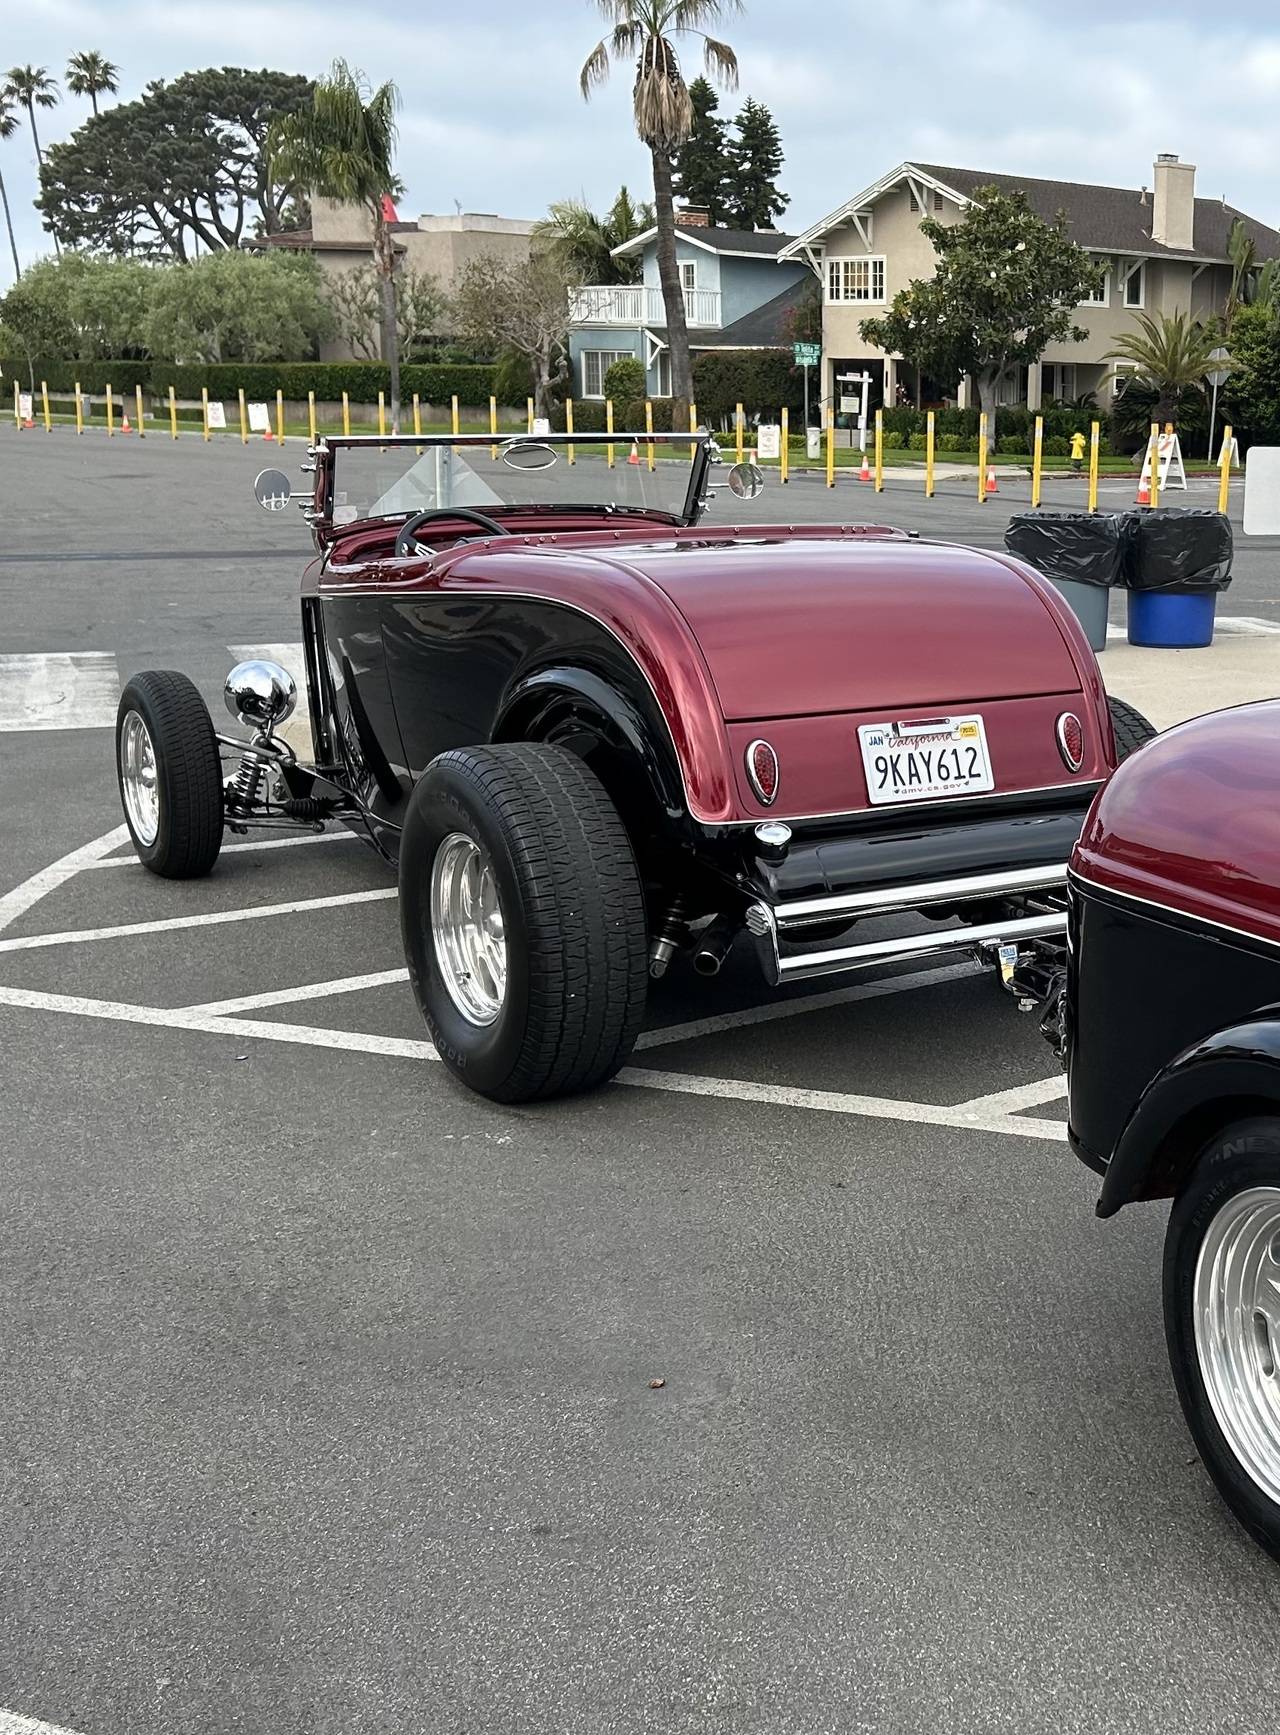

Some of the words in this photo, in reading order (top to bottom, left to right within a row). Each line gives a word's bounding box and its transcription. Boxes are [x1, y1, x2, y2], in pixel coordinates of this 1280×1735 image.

[868, 736, 884, 747] JAN
[874, 746, 982, 790] 9KAY612
[901, 782, 962, 795] dmv.ca.gov
